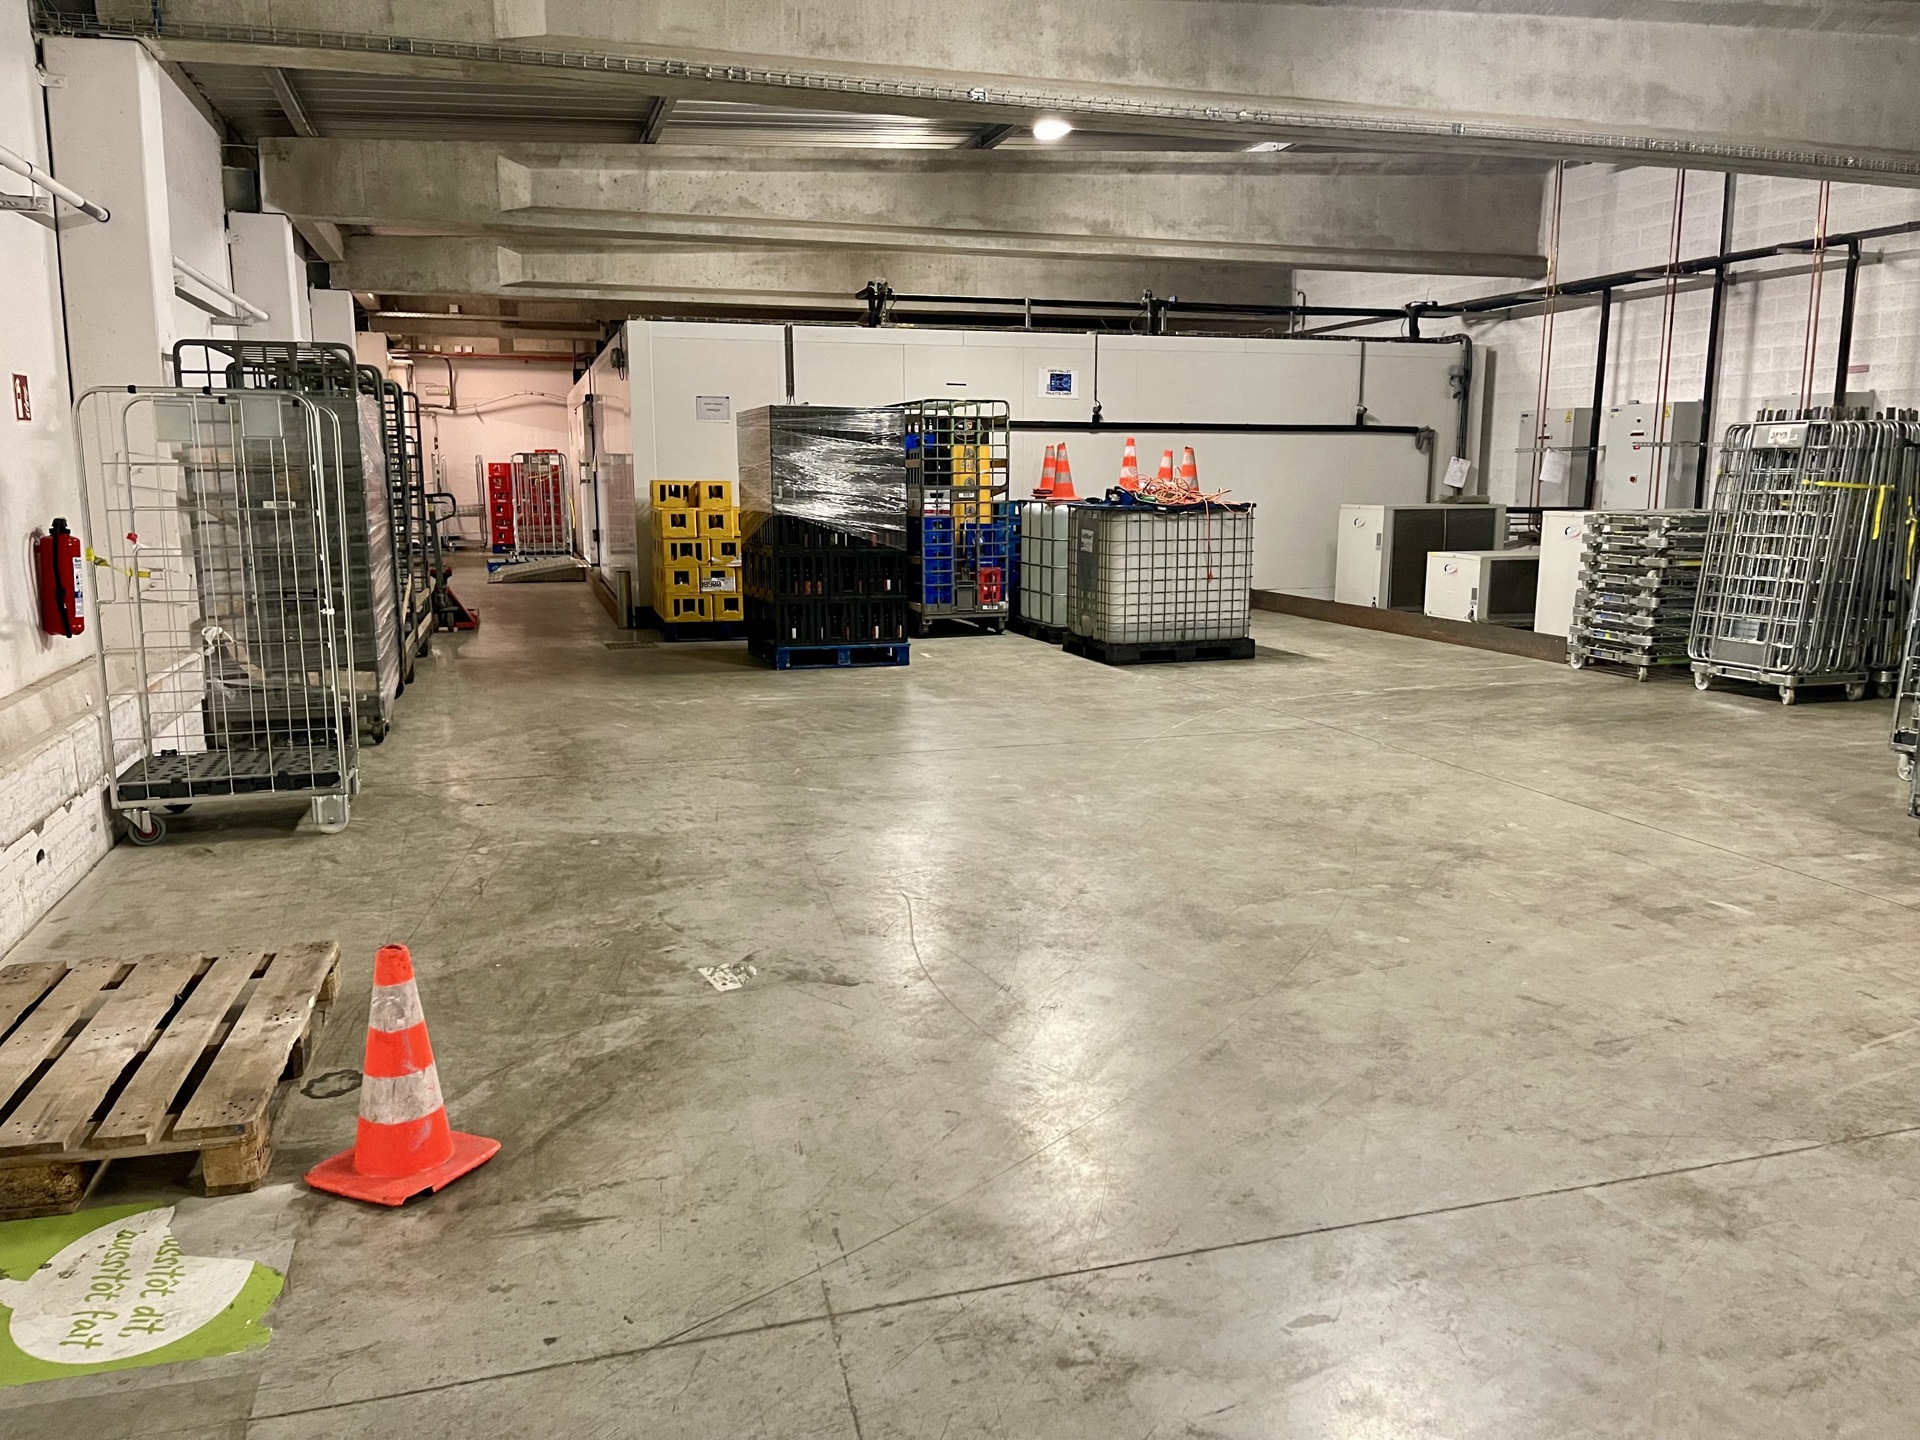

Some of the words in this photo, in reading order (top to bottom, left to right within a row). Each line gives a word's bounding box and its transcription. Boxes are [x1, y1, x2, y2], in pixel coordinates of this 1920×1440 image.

[84, 1229, 138, 1302] aussitôt
[139, 1234, 186, 1298] ussitôt
[58, 1310, 118, 1349] fait
[117, 1306, 165, 1337] dit,
